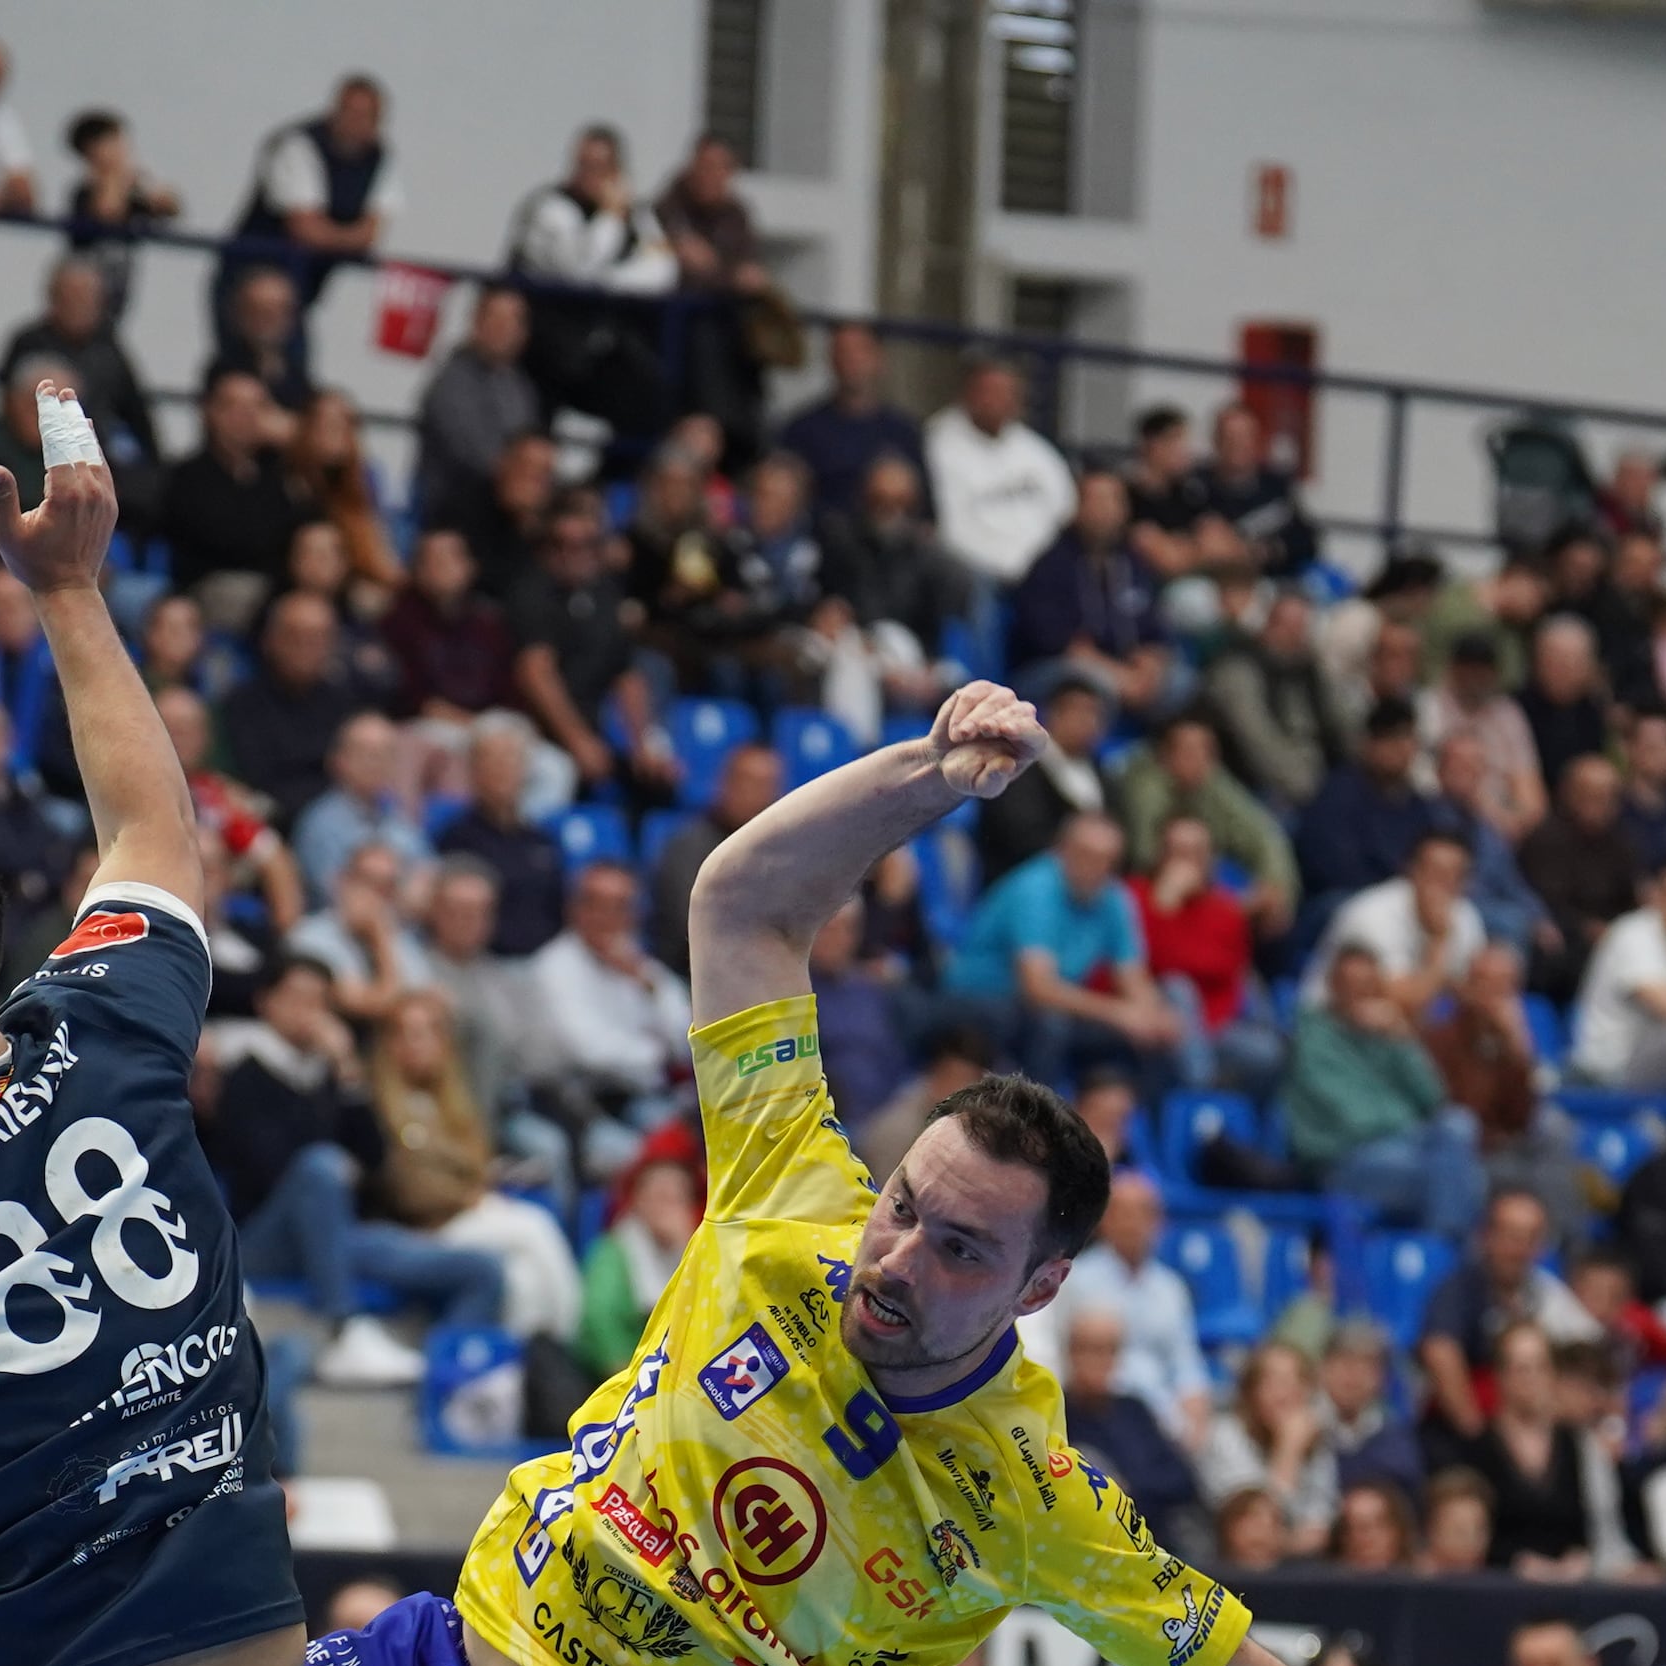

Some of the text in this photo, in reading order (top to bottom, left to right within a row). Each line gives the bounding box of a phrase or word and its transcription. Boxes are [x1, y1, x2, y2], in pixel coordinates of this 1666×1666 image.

[767, 1305, 803, 1351] ARRIBAS
[791, 1313, 817, 1348] PABLO
[121, 1388, 182, 1420] ALICANTE
[703, 1376, 733, 1413] asobal
[821, 1388, 903, 1481] 9
[600, 1491, 671, 1558] Pascual
